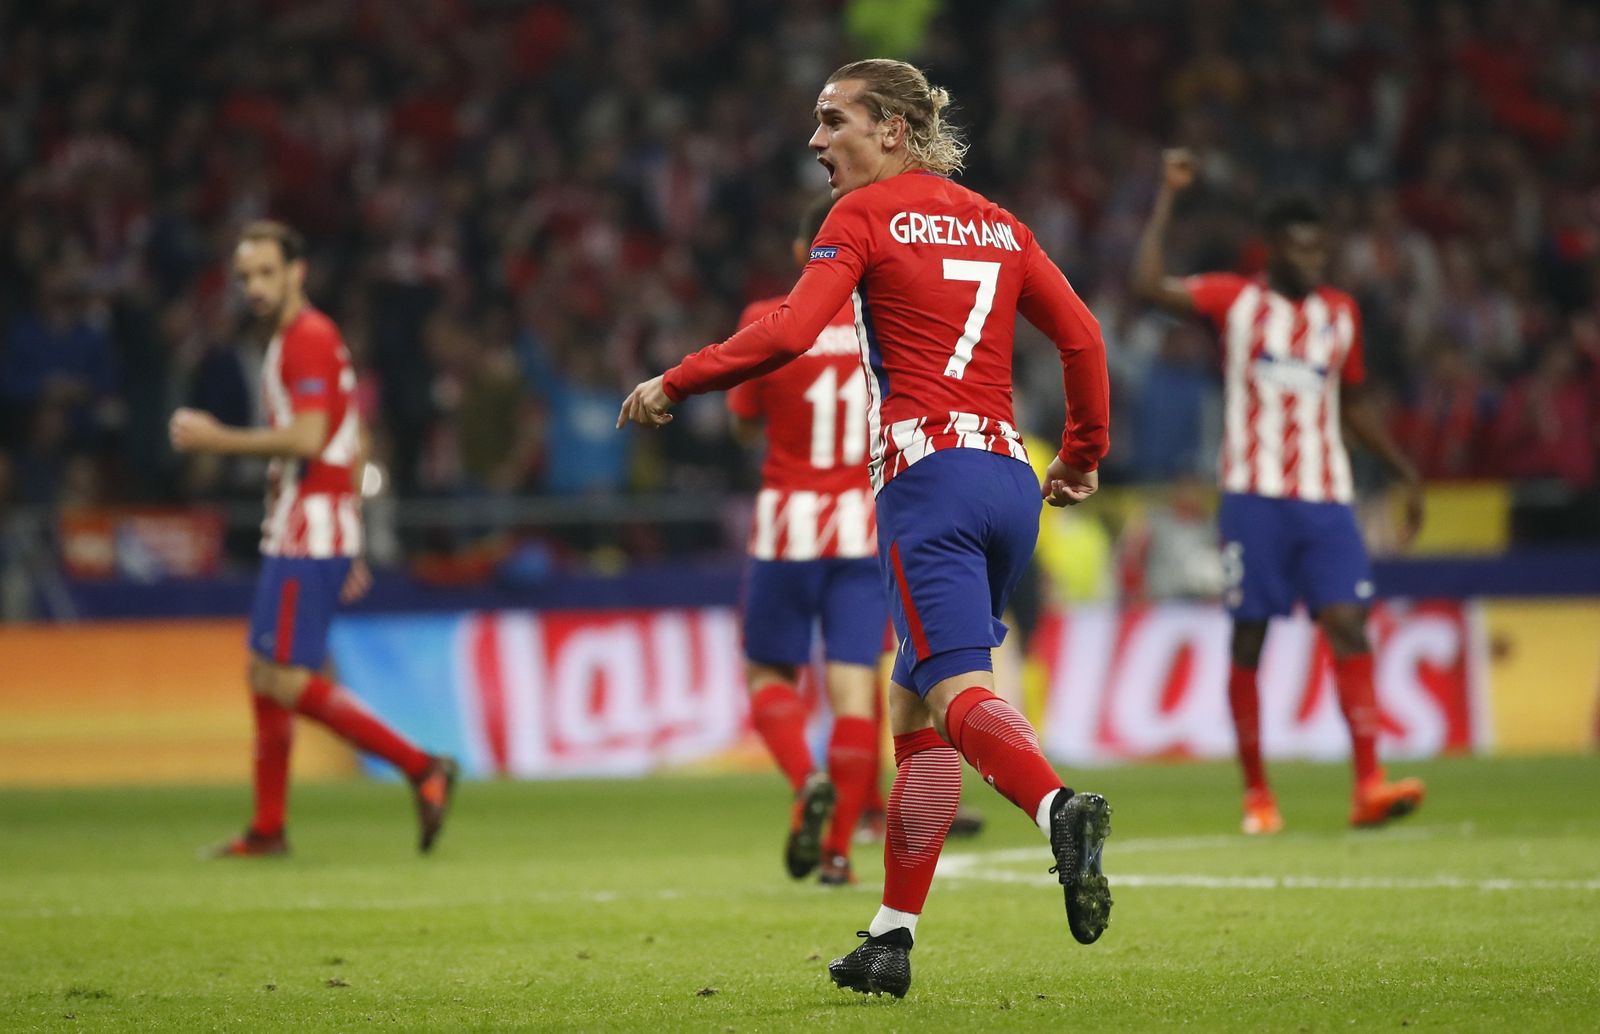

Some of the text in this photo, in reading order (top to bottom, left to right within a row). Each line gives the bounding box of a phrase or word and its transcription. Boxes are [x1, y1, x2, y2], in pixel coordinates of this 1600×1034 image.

[889, 211, 1021, 251] GRIEZMANN
[942, 258, 1001, 380] 7
[804, 364, 869, 468] 11
